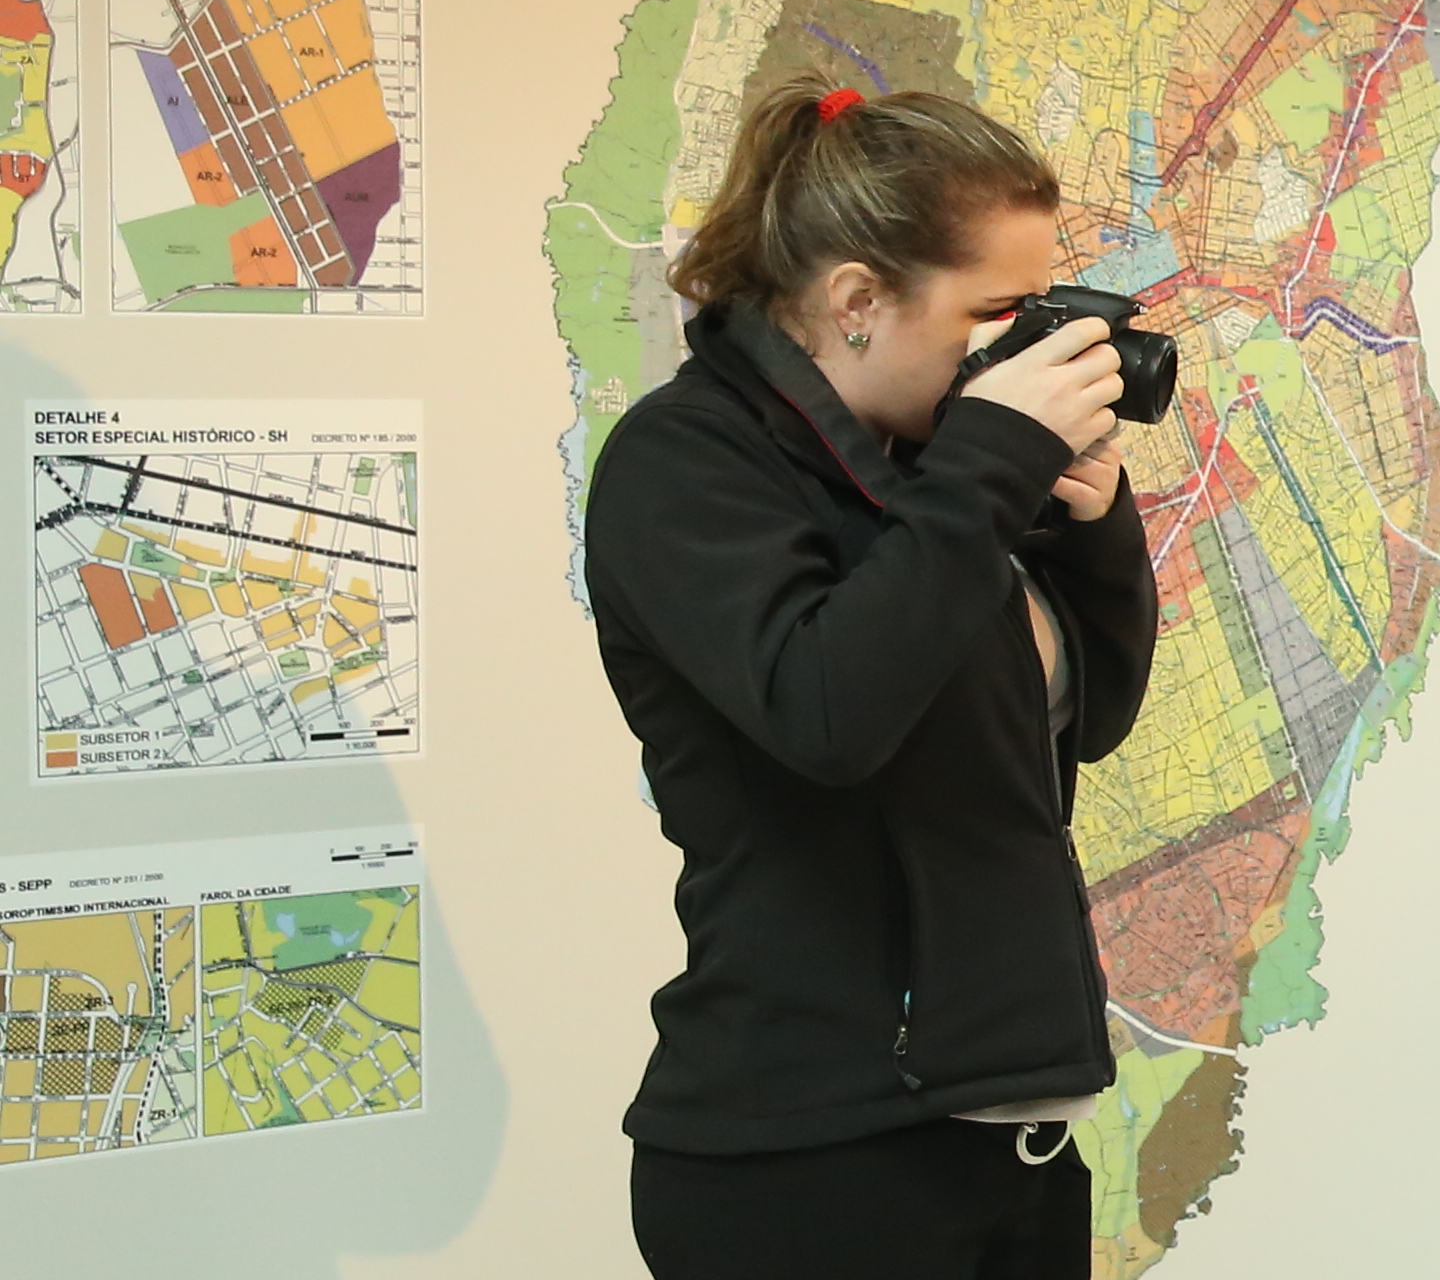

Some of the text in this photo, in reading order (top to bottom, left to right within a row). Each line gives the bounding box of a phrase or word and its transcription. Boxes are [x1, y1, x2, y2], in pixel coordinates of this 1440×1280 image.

[300, 47, 324, 58] AR-1
[35, 411, 120, 425] DETALHE 4
[35, 431, 88, 445] SETOR
[92, 430, 169, 444] ESPECIAL
[173, 428, 255, 444] HISTÓRICO
[269, 430, 288, 443] SH
[80, 731, 149, 746] SUBSETOR
[80, 749, 150, 764] SUBSETOR
[18, 879, 52, 892] SEPP
[201, 885, 291, 901] FAROL DA CIDADE
[84, 896, 169, 913] INTERNACIONAL
[150, 1108, 178, 1120] ZR-1
